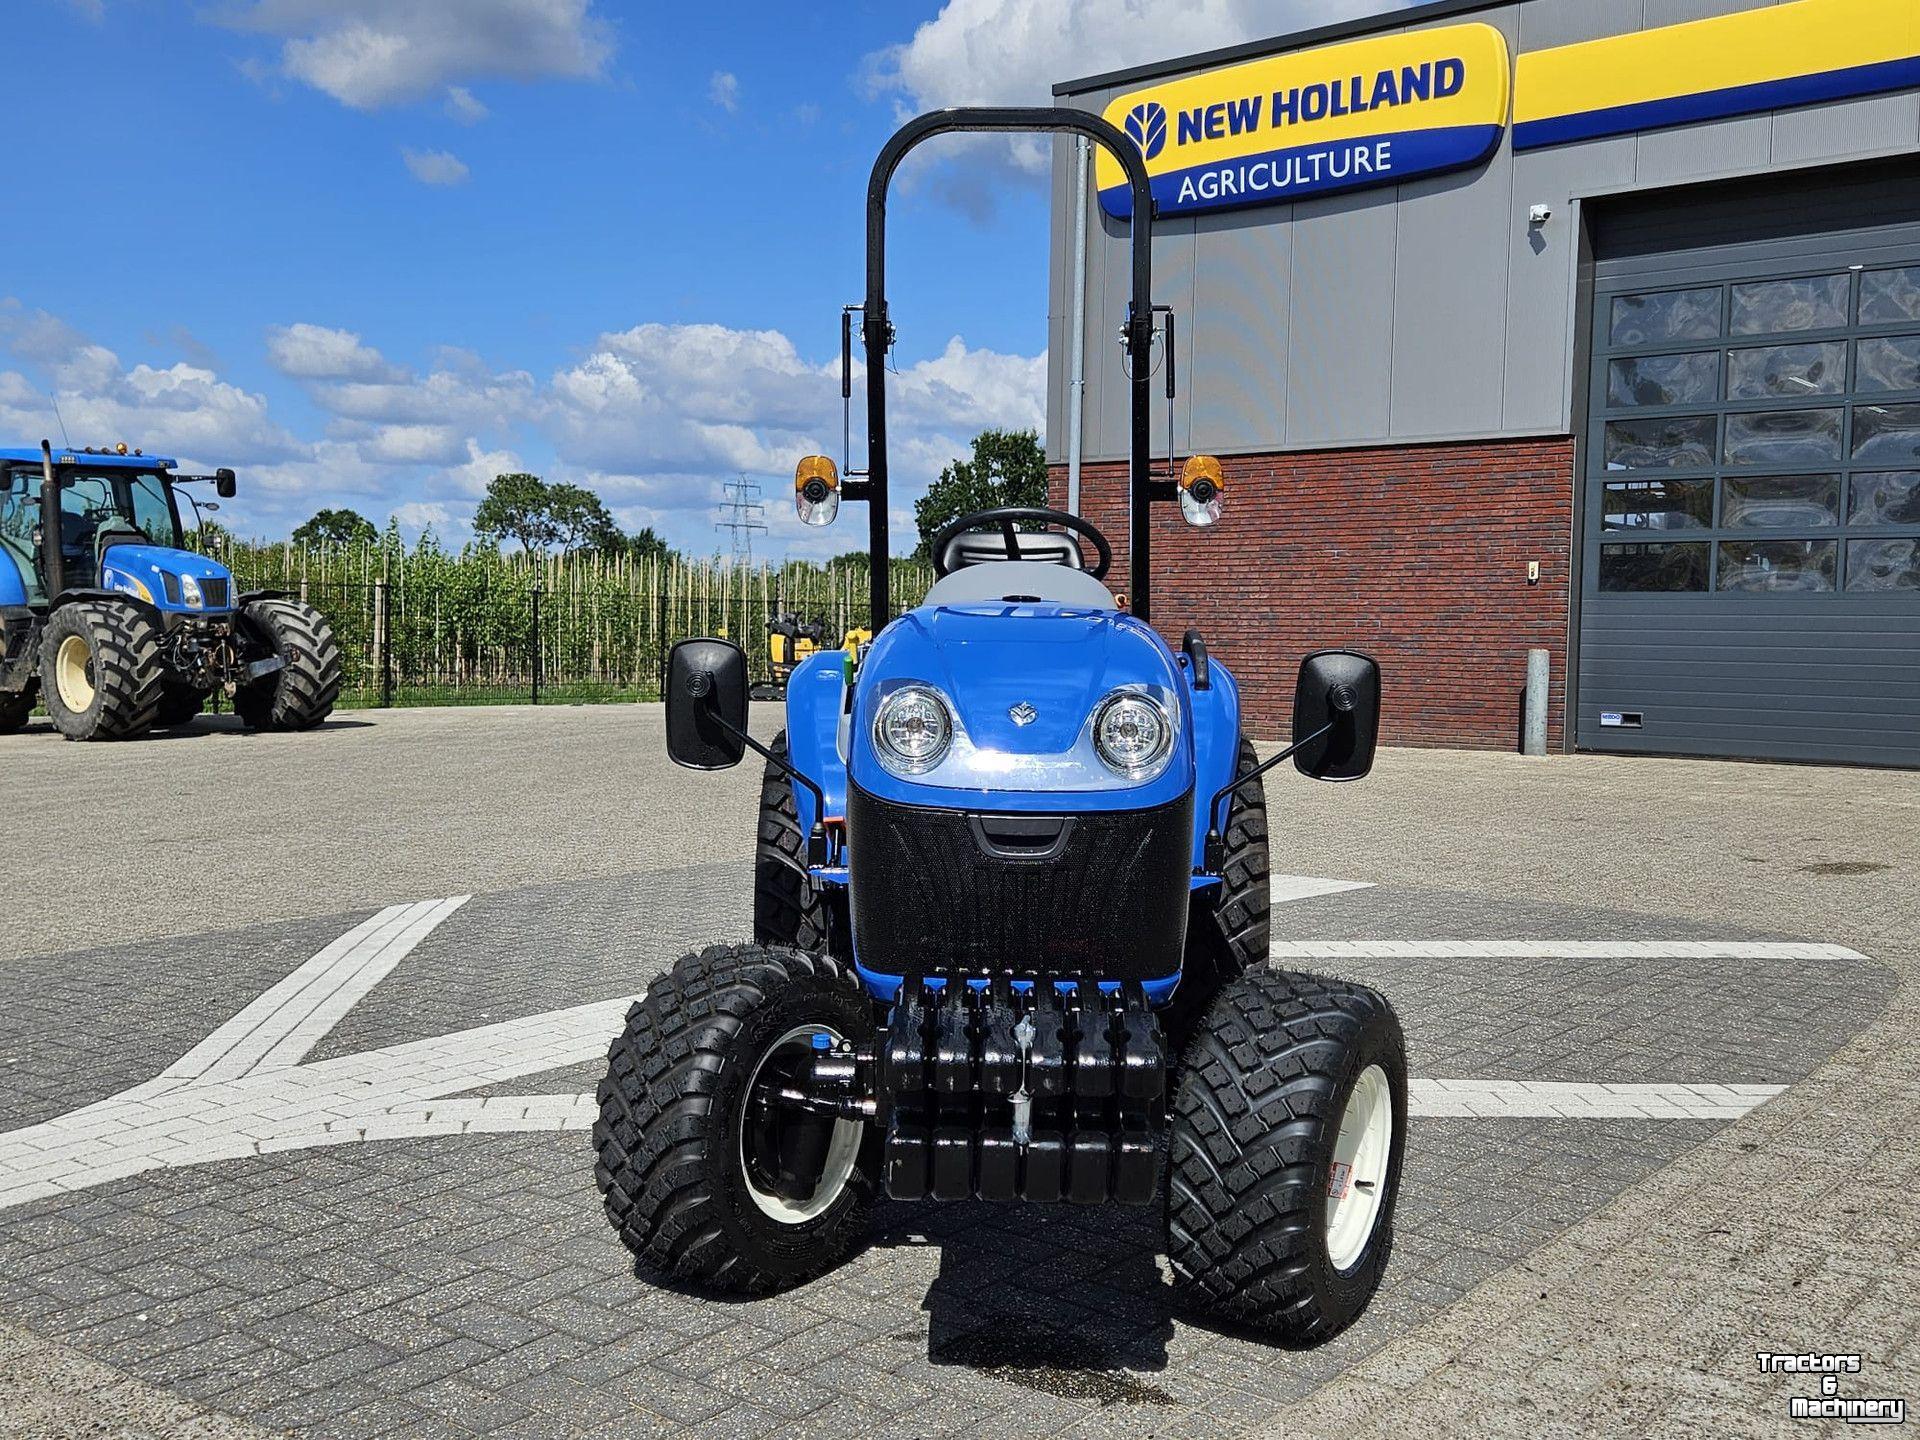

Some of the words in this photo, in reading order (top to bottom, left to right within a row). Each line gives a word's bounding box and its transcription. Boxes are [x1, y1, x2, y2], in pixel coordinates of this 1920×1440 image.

[1178, 97, 1263, 146] NEW
[1271, 58, 1465, 128] HOLLAND
[1177, 142, 1391, 203] AGRICULTURE
